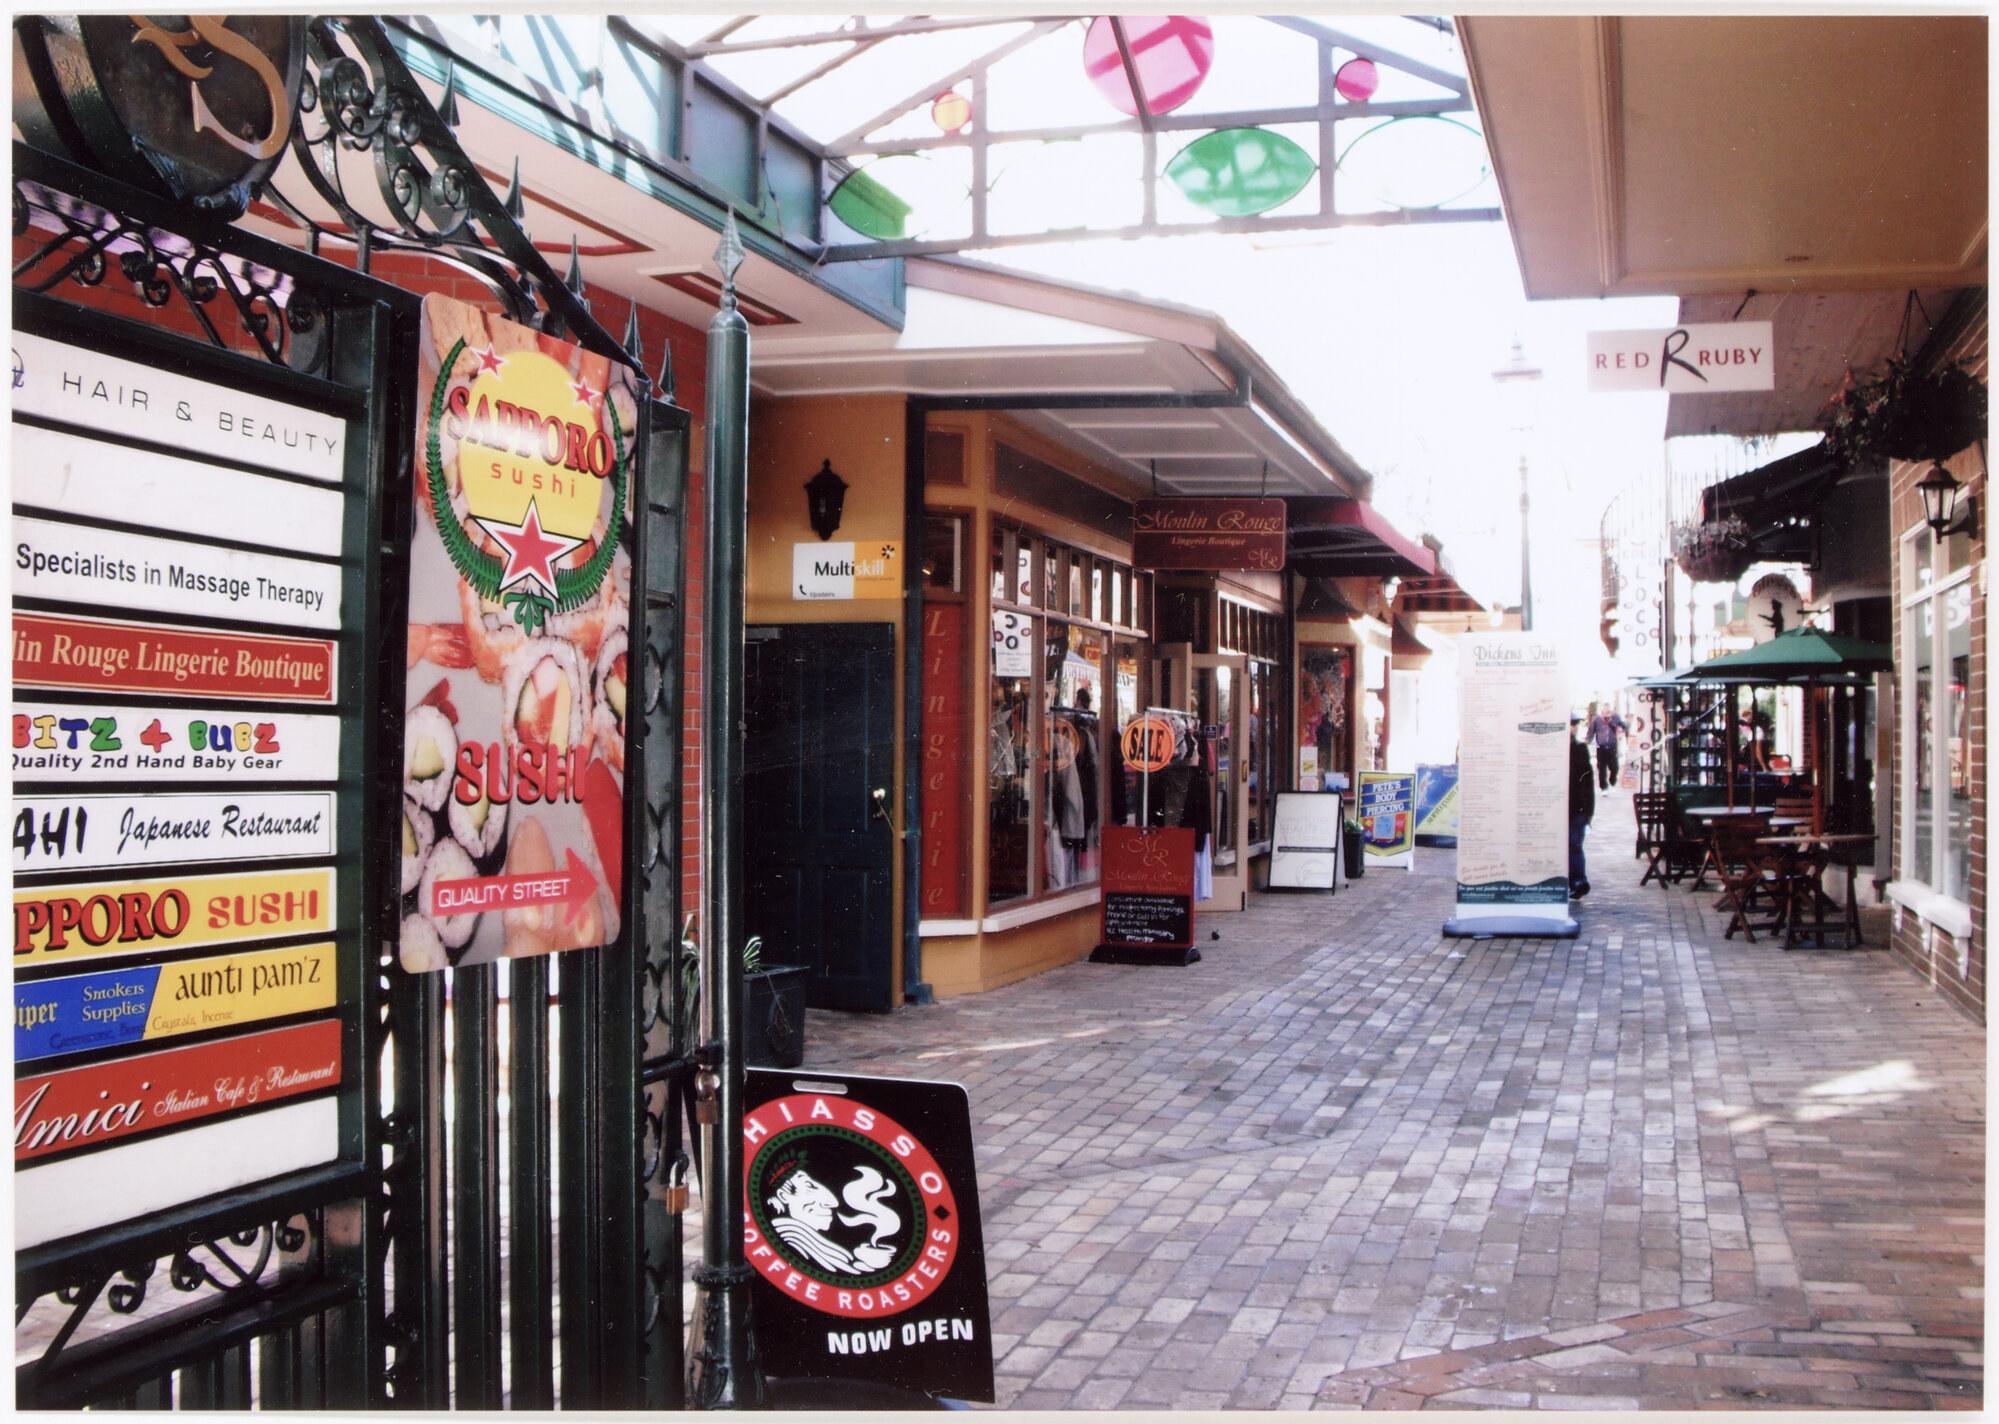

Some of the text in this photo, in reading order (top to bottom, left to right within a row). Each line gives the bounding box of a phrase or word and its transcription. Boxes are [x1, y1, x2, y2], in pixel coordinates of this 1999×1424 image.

[1596, 329, 1762, 388] RED R RUBY
[62, 371, 149, 412] HAIR
[175, 400, 193, 423] &
[218, 411, 338, 456] BEAUTY
[447, 385, 614, 479] SAPPORO
[490, 461, 577, 499] sushi
[1136, 510, 1281, 536] Moulin Rouge
[1171, 536, 1245, 548] Lingerie Boutique
[16, 543, 324, 611] Specialists in Massage Therapy
[814, 559, 885, 576] Multiskill
[51, 633, 129, 676] Rouge
[137, 641, 230, 682] Lingerie
[235, 649, 324, 691] Boutique
[1473, 644, 1556, 661] Dickens Inn
[140, 718, 172, 754] 4
[188, 720, 281, 754] BUBZ
[1129, 727, 1164, 763] SALE
[90, 754, 129, 769] 2nd
[136, 755, 185, 769] Hand
[192, 755, 236, 772] Baby
[243, 757, 283, 770] Gear
[455, 740, 588, 805] SUSHI
[927, 610, 947, 905] Lingerie
[1372, 781, 1402, 792] PETE'S
[1376, 792, 1397, 803] BODY
[1366, 803, 1405, 816] PIERCING
[117, 807, 211, 856] Japanese
[222, 804, 321, 838] Restaurant
[438, 877, 571, 908] QUALITY STREET
[14, 888, 319, 955] PPORO SUSHI
[83, 982, 145, 1003] Smokers
[175, 955, 321, 1001] aunti pam'z
[82, 1001, 146, 1022] Supplies
[153, 1090, 209, 1117] Italian
[213, 1076, 245, 1109] Cafe
[266, 1062, 336, 1091] Restaurant
[744, 1212, 951, 1311] OFFEE ROASTERS
[828, 1318, 974, 1355] NOW OPEN
